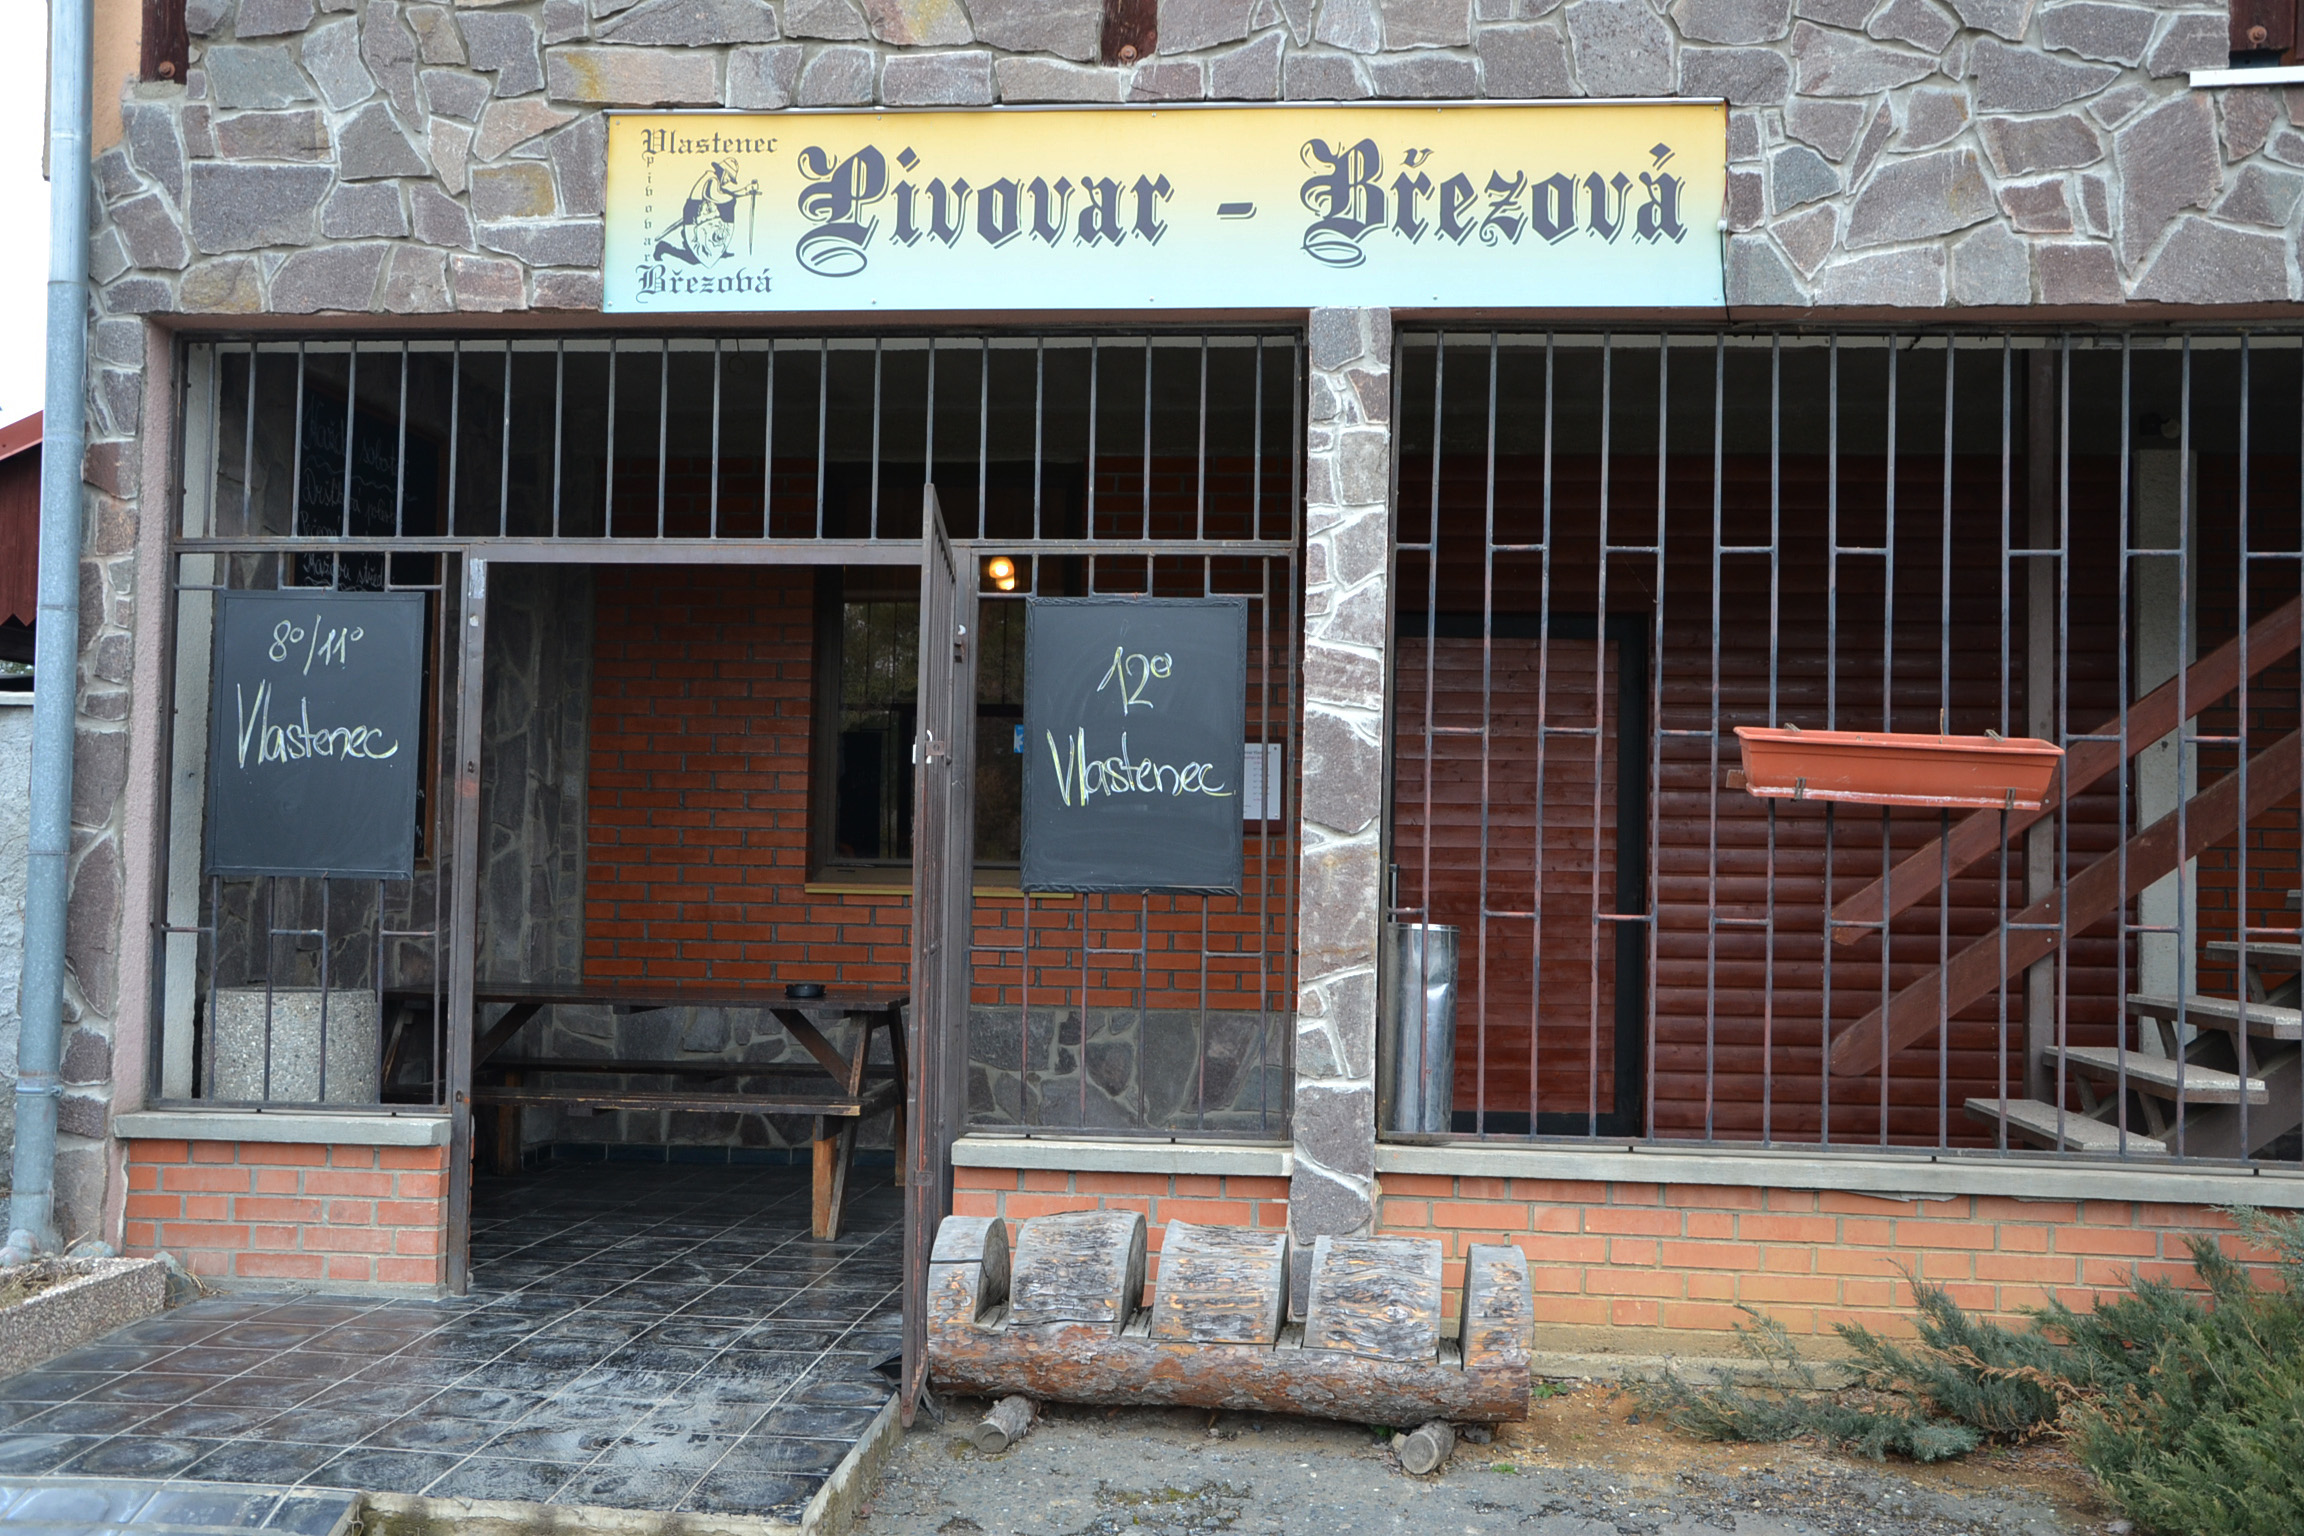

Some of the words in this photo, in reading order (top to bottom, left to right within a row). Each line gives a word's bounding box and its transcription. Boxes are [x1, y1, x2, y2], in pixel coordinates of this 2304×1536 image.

[641, 128, 778, 161] Vlastenec
[796, 144, 1175, 278] Pivovar
[1299, 137, 1686, 269] Březová
[635, 264, 773, 304] Březová
[236, 679, 399, 769] Vlastenec
[1047, 726, 1234, 807] Vlastenec
